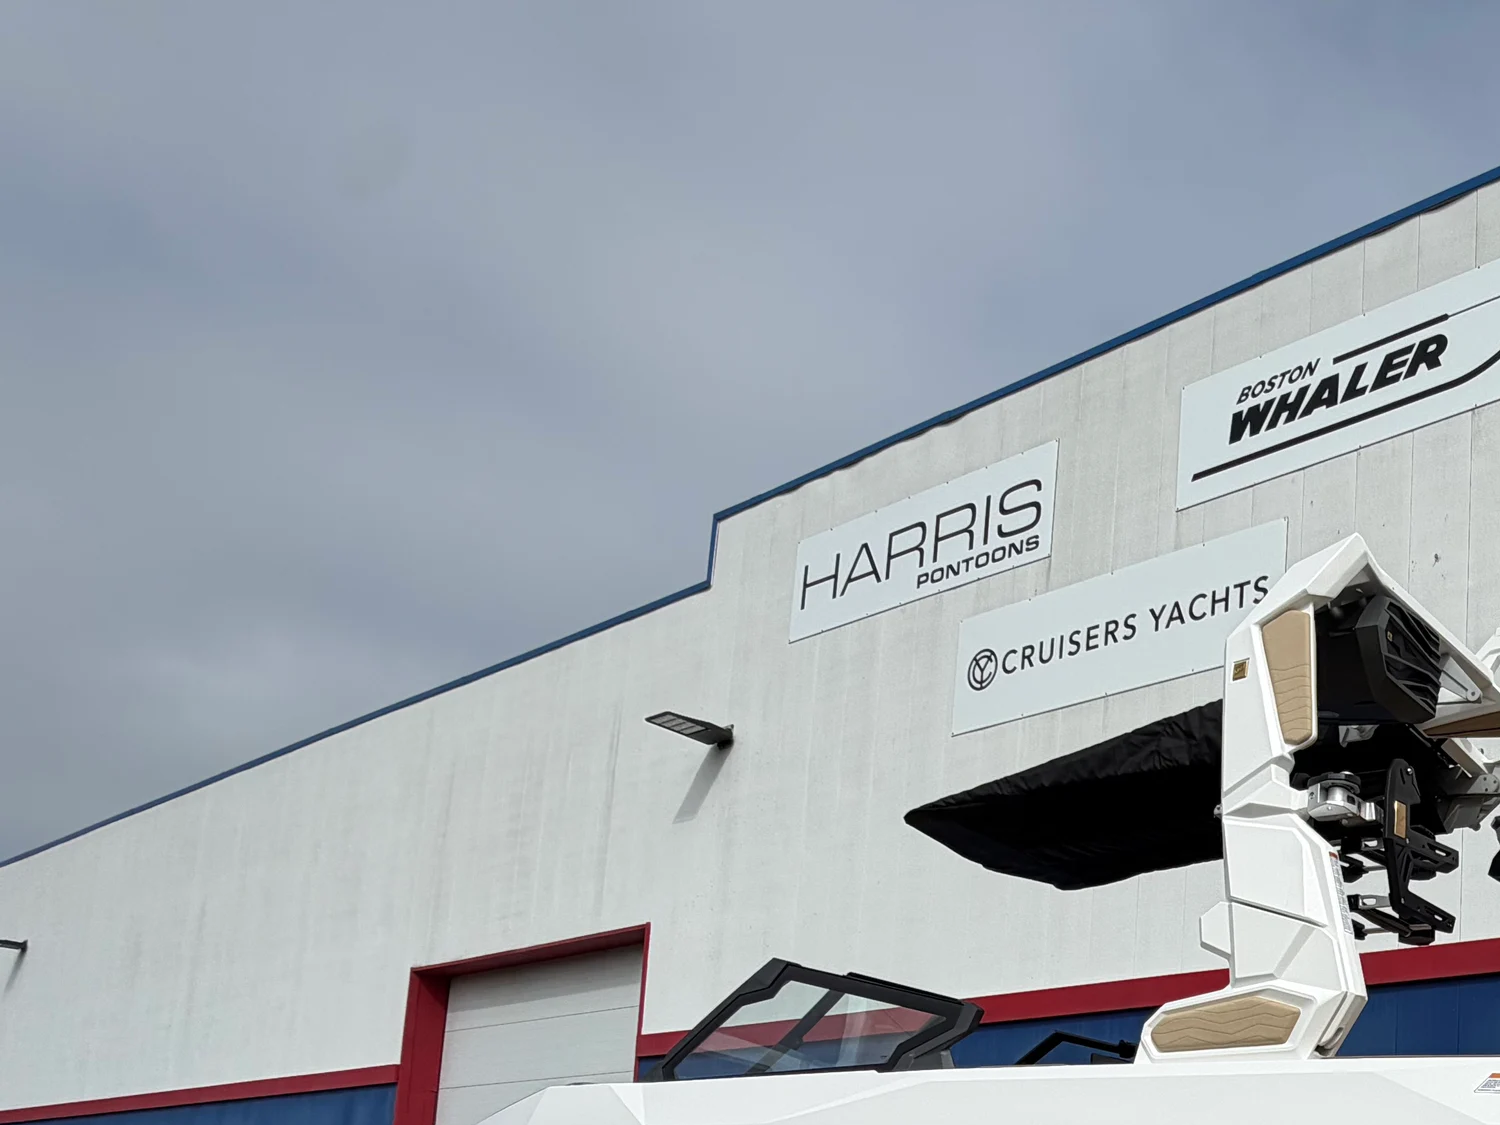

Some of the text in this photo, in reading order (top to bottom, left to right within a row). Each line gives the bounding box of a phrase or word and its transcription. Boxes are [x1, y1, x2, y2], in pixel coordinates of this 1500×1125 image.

[1228, 333, 1448, 445] WHALER
[1236, 357, 1321, 405] BOSTON
[800, 478, 1042, 611] HARRIS
[916, 534, 1040, 589] PONTOONS
[1001, 613, 1137, 675] CRUISERS
[1149, 575, 1269, 632] YACHTS
